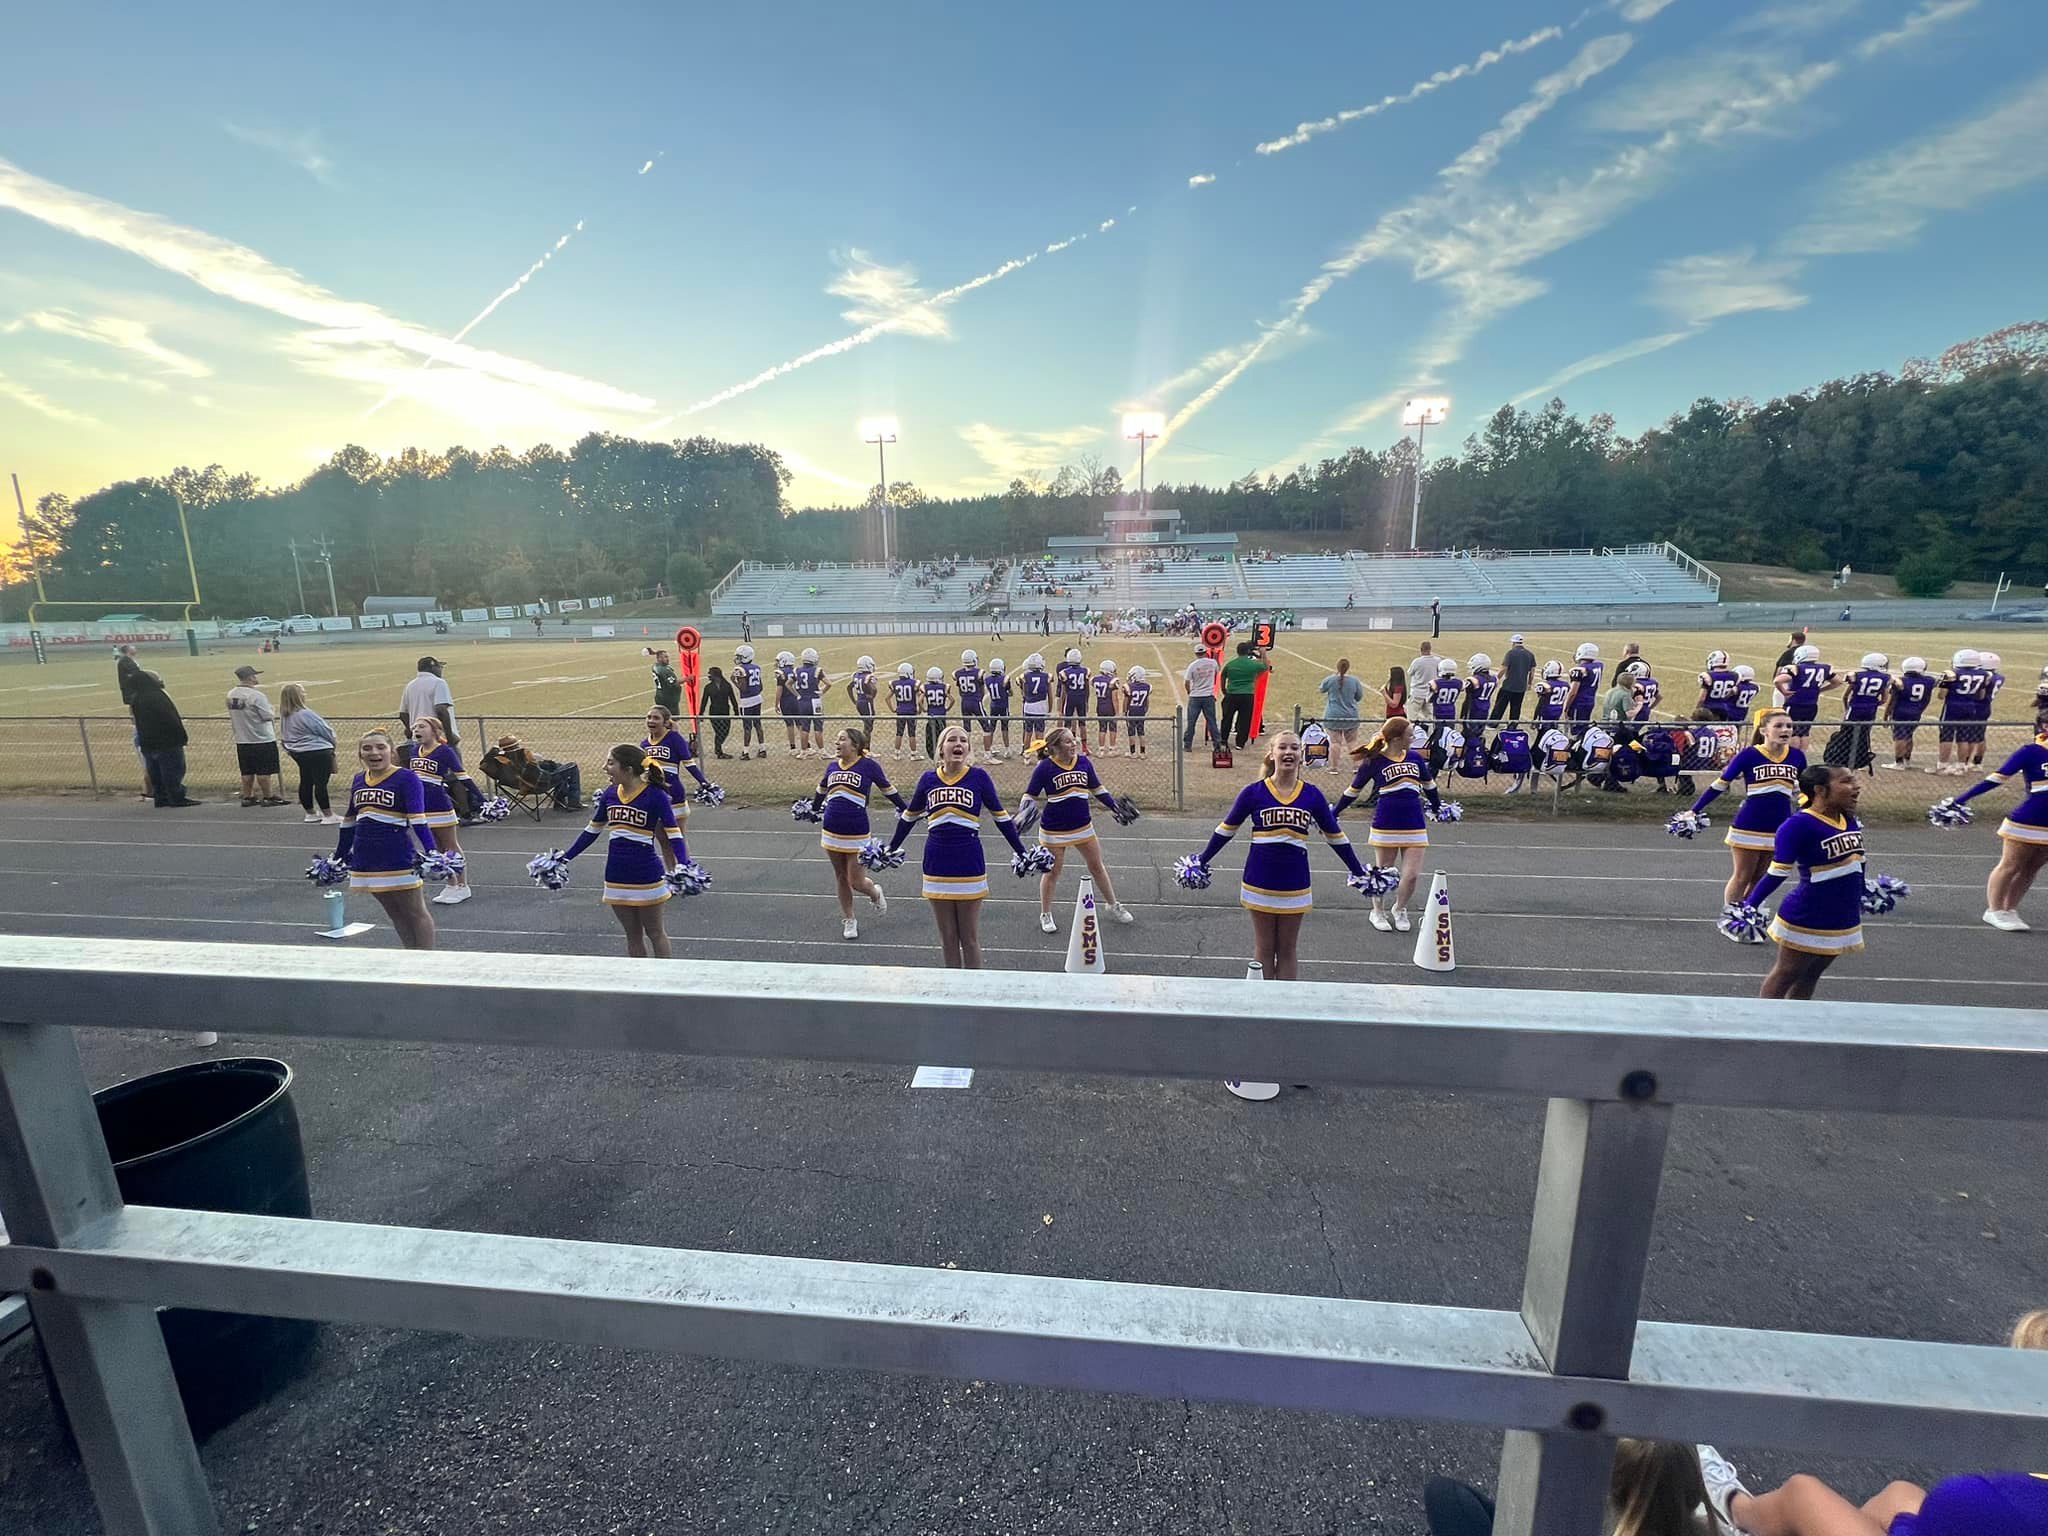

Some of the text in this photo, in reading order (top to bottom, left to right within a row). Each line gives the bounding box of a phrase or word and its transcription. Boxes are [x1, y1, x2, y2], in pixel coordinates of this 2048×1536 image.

[1257, 626, 1270, 646] 3
[749, 668, 761, 686] 29
[958, 676, 976, 693] 85
[1031, 677, 1041, 694] 7
[1068, 674, 1084, 690] 34
[1802, 668, 1825, 687] 74
[1956, 675, 1985, 695] 37
[895, 685, 912, 702] 30
[989, 683, 1001, 700] 11
[1478, 682, 1495, 700] 17
[1857, 677, 1883, 696] 12
[1910, 684, 1925, 701] 9
[926, 690, 944, 706] 26
[1130, 690, 1148, 706] 27
[1550, 687, 1568, 705] 20
[641, 746, 671, 760] GERS
[1698, 737, 1715, 757] 81
[409, 757, 439, 774] GERS
[1381, 763, 1421, 781] TIGERS
[1753, 764, 1798, 781] TIGERS
[1052, 771, 1088, 790] TIGERS
[927, 786, 974, 809] TIGERS
[1260, 806, 1311, 829] TIGERS
[1821, 831, 1864, 860] TIGER
[1081, 915, 1097, 965] SMS
[1436, 912, 1452, 963] SMS
